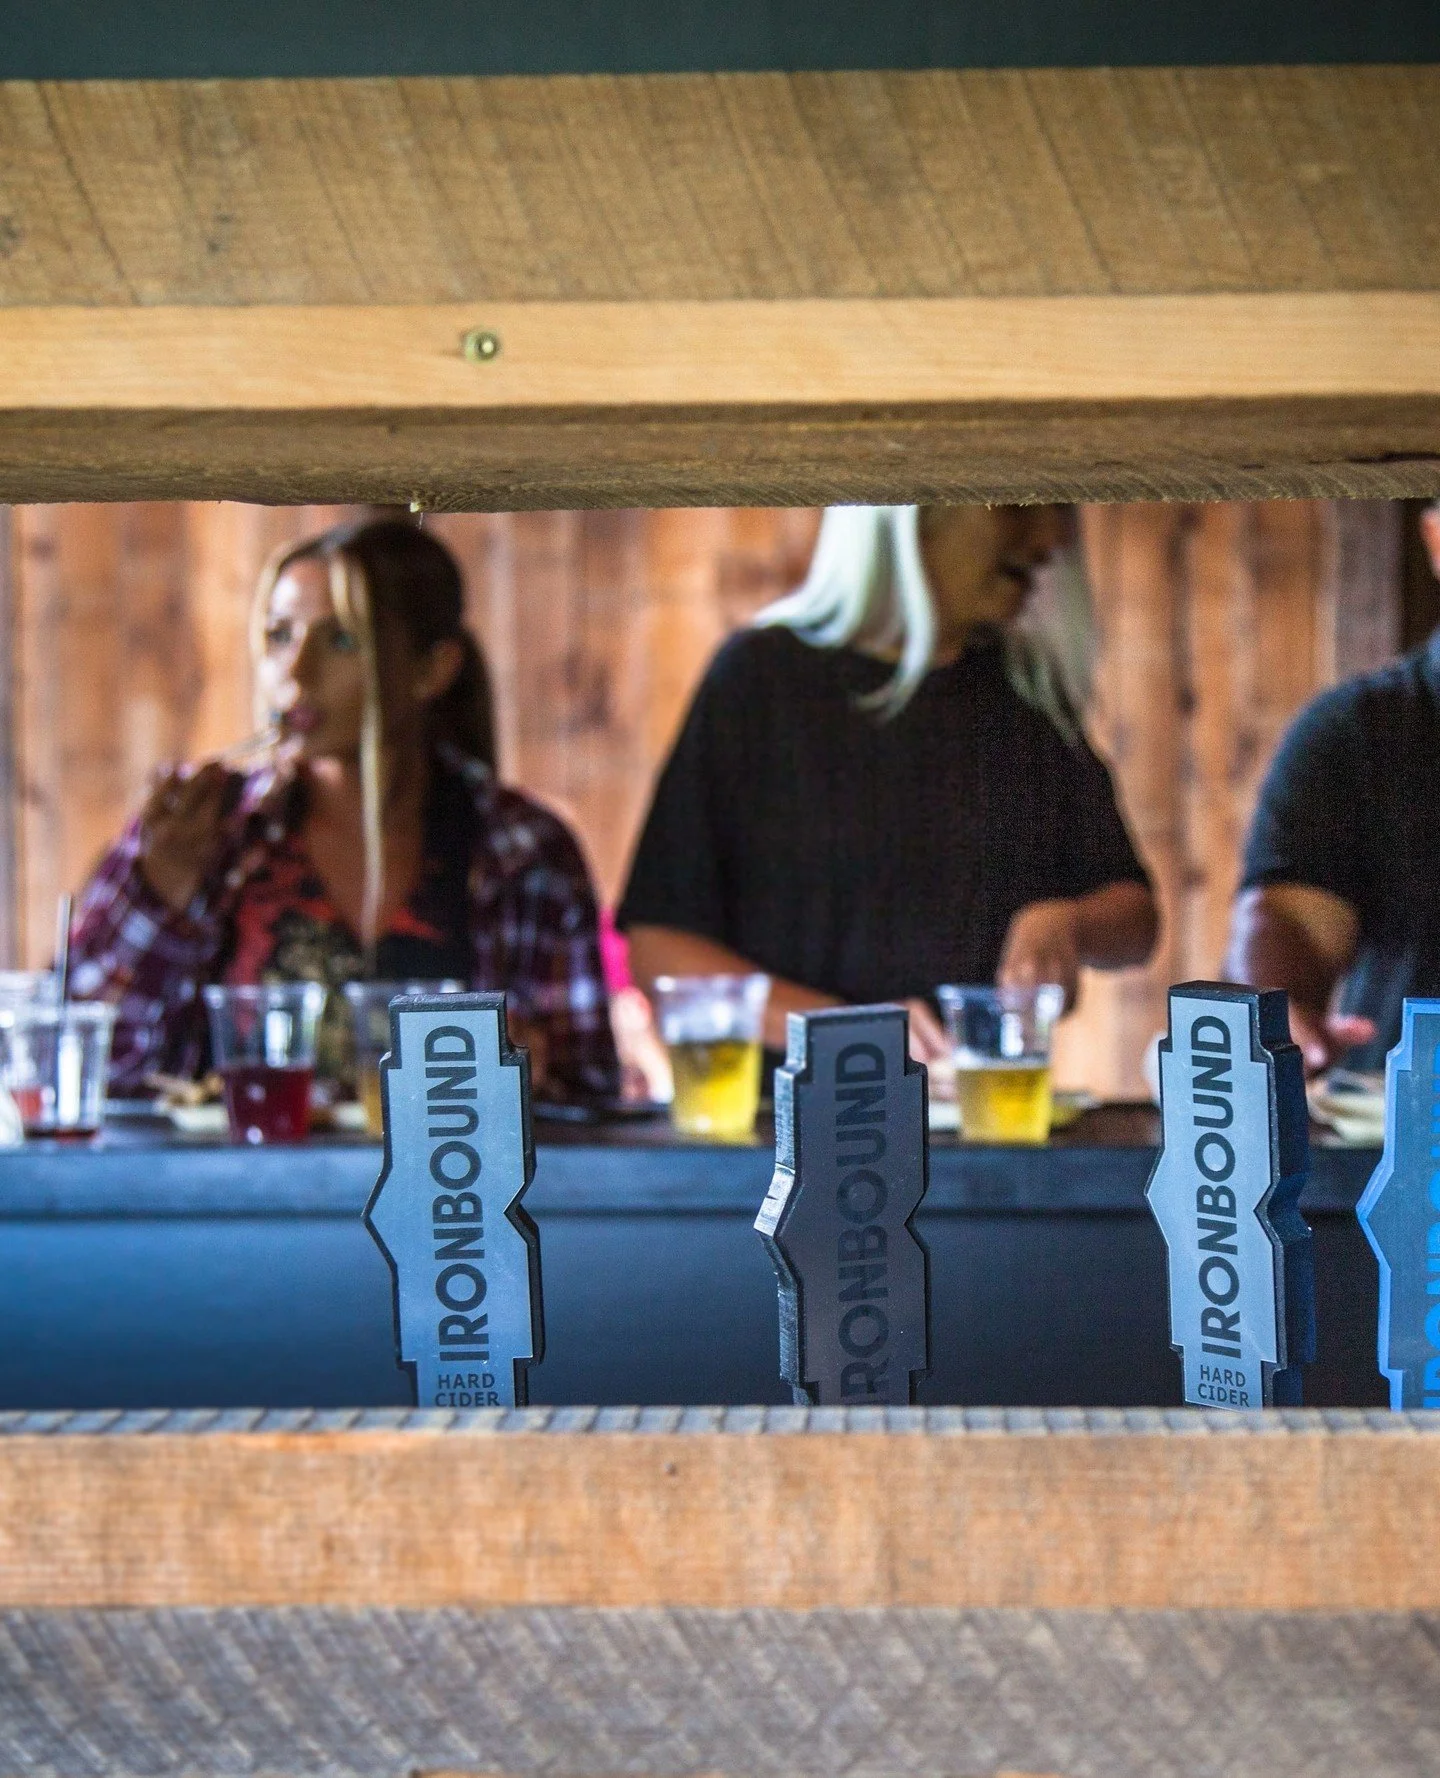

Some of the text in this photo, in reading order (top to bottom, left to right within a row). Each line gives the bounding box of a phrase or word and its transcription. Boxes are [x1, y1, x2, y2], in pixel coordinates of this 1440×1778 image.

[424, 1025, 490, 1361] IRONBOUND
[1191, 1015, 1242, 1359] IRONBOUND
[835, 1042, 889, 1406] RONBOUND
[437, 1373, 496, 1389] HARD
[1200, 1364, 1246, 1387] HARD
[434, 1391, 500, 1407] CIDER
[1197, 1383, 1250, 1407] CIDER
